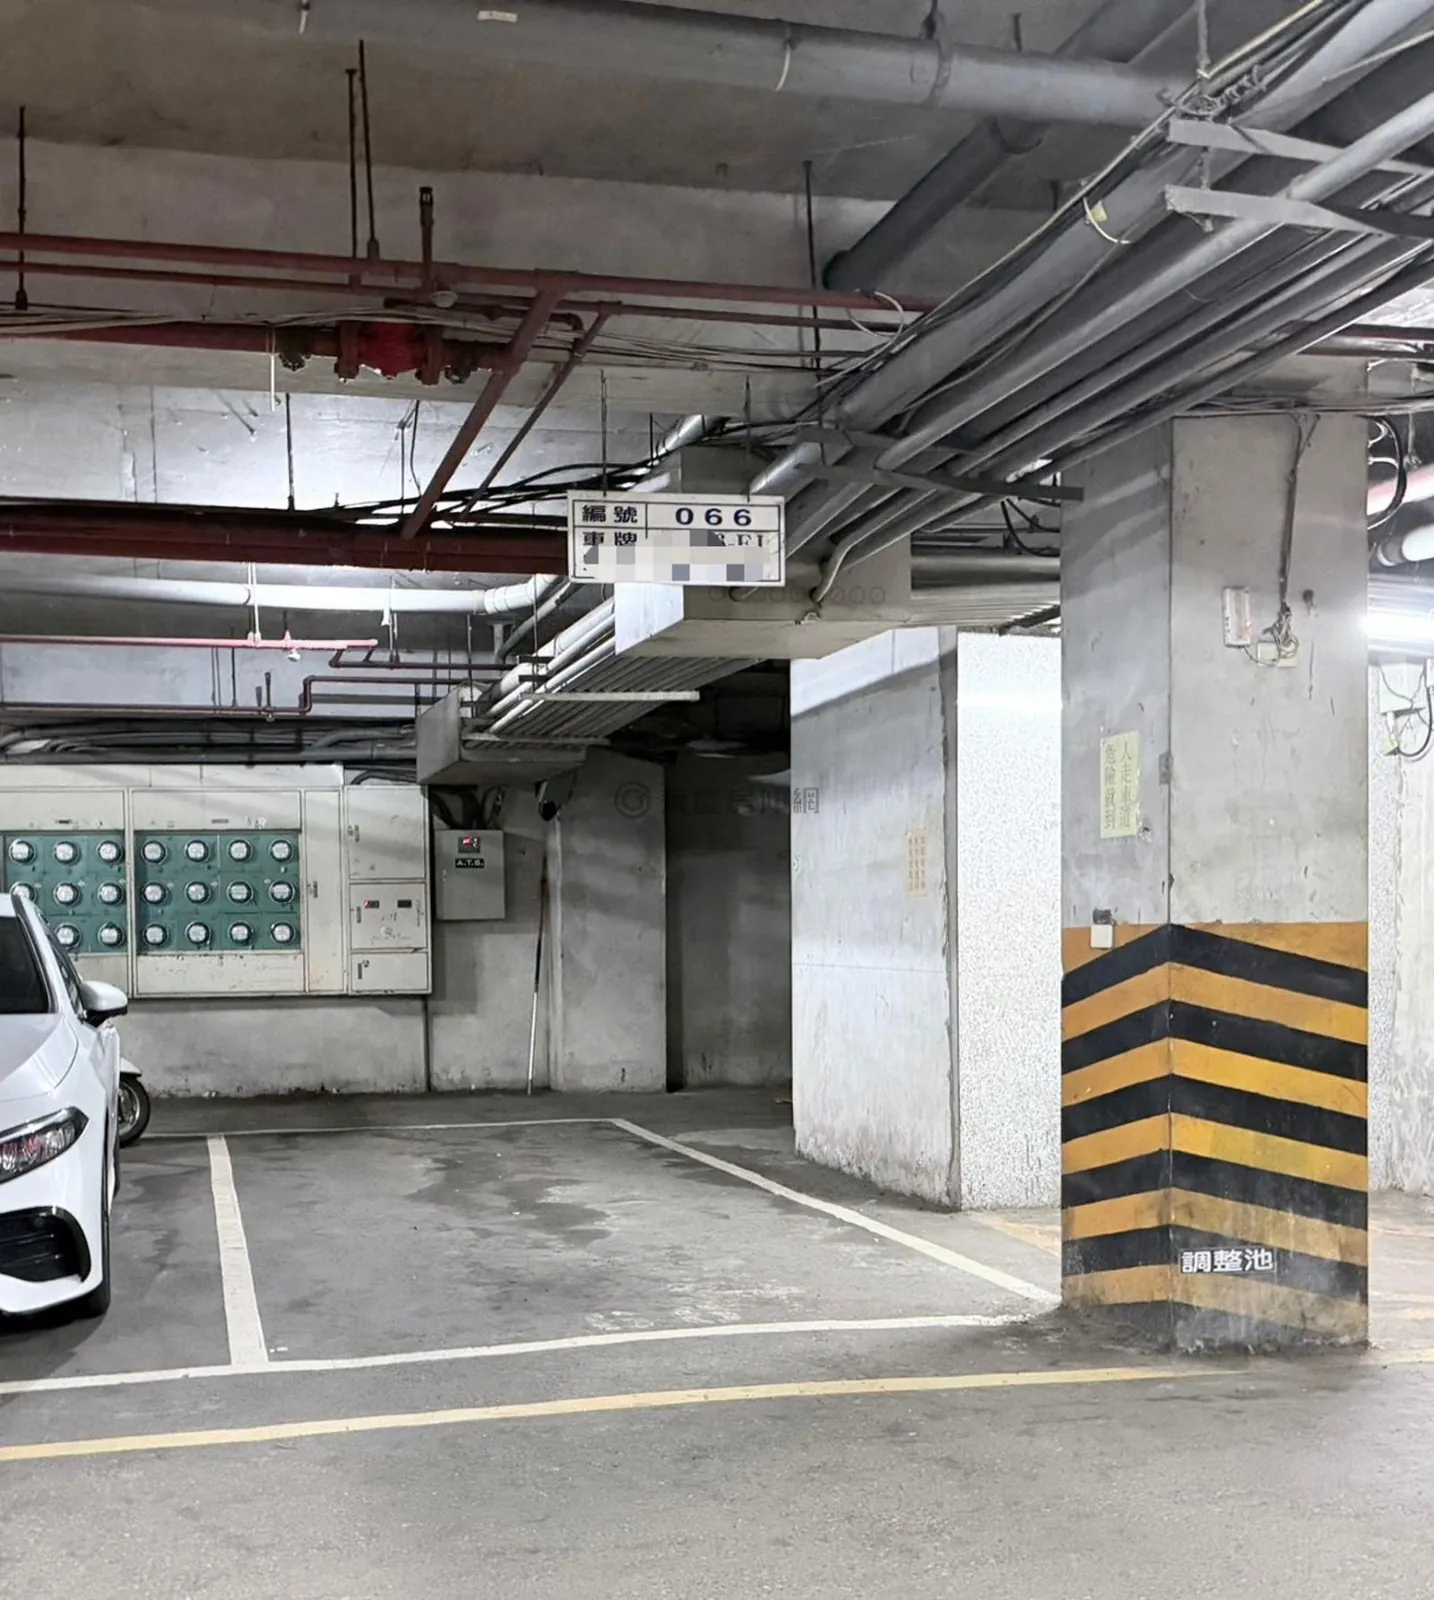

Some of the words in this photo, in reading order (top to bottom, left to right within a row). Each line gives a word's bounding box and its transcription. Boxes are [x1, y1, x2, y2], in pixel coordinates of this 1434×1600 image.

[582, 505, 638, 523] 編號
[675, 507, 752, 526] 066
[1182, 1248, 1274, 1273] 調整池
